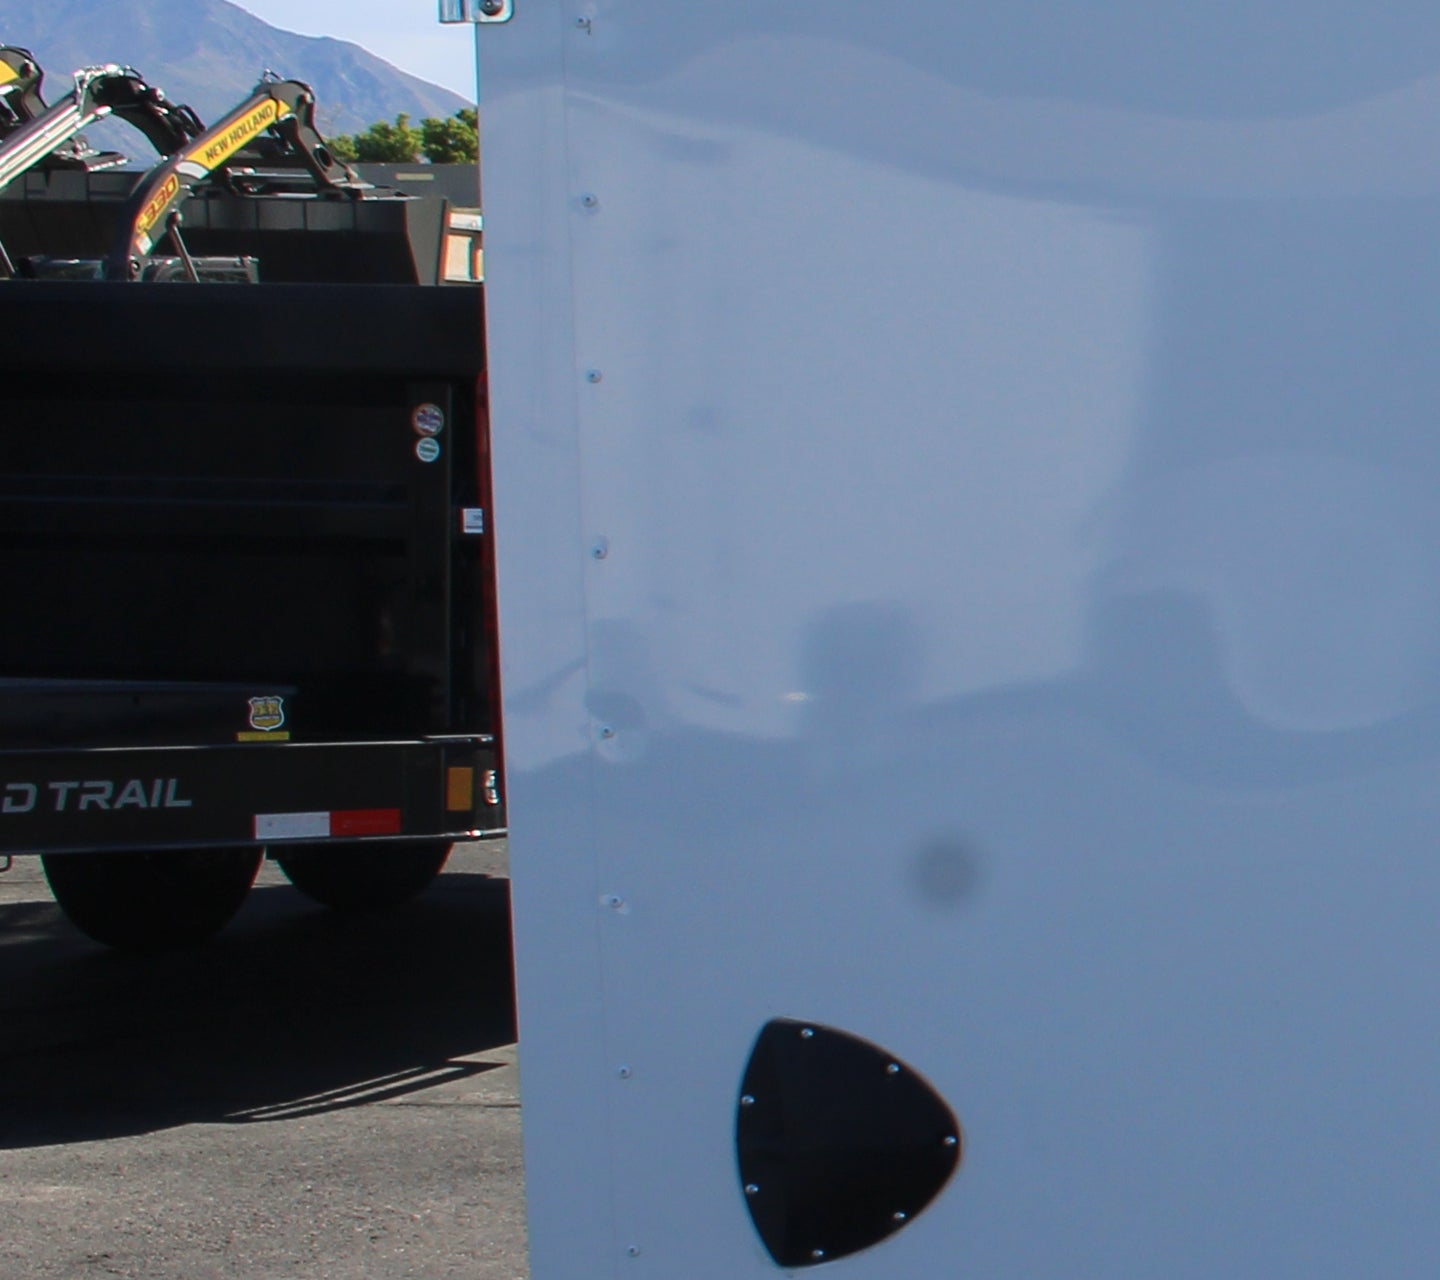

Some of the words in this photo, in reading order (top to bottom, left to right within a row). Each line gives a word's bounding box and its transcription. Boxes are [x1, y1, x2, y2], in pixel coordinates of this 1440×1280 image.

[205, 138, 230, 162] NEW
[230, 105, 274, 148] HOLLAND
[47, 778, 193, 812] TRAIL
